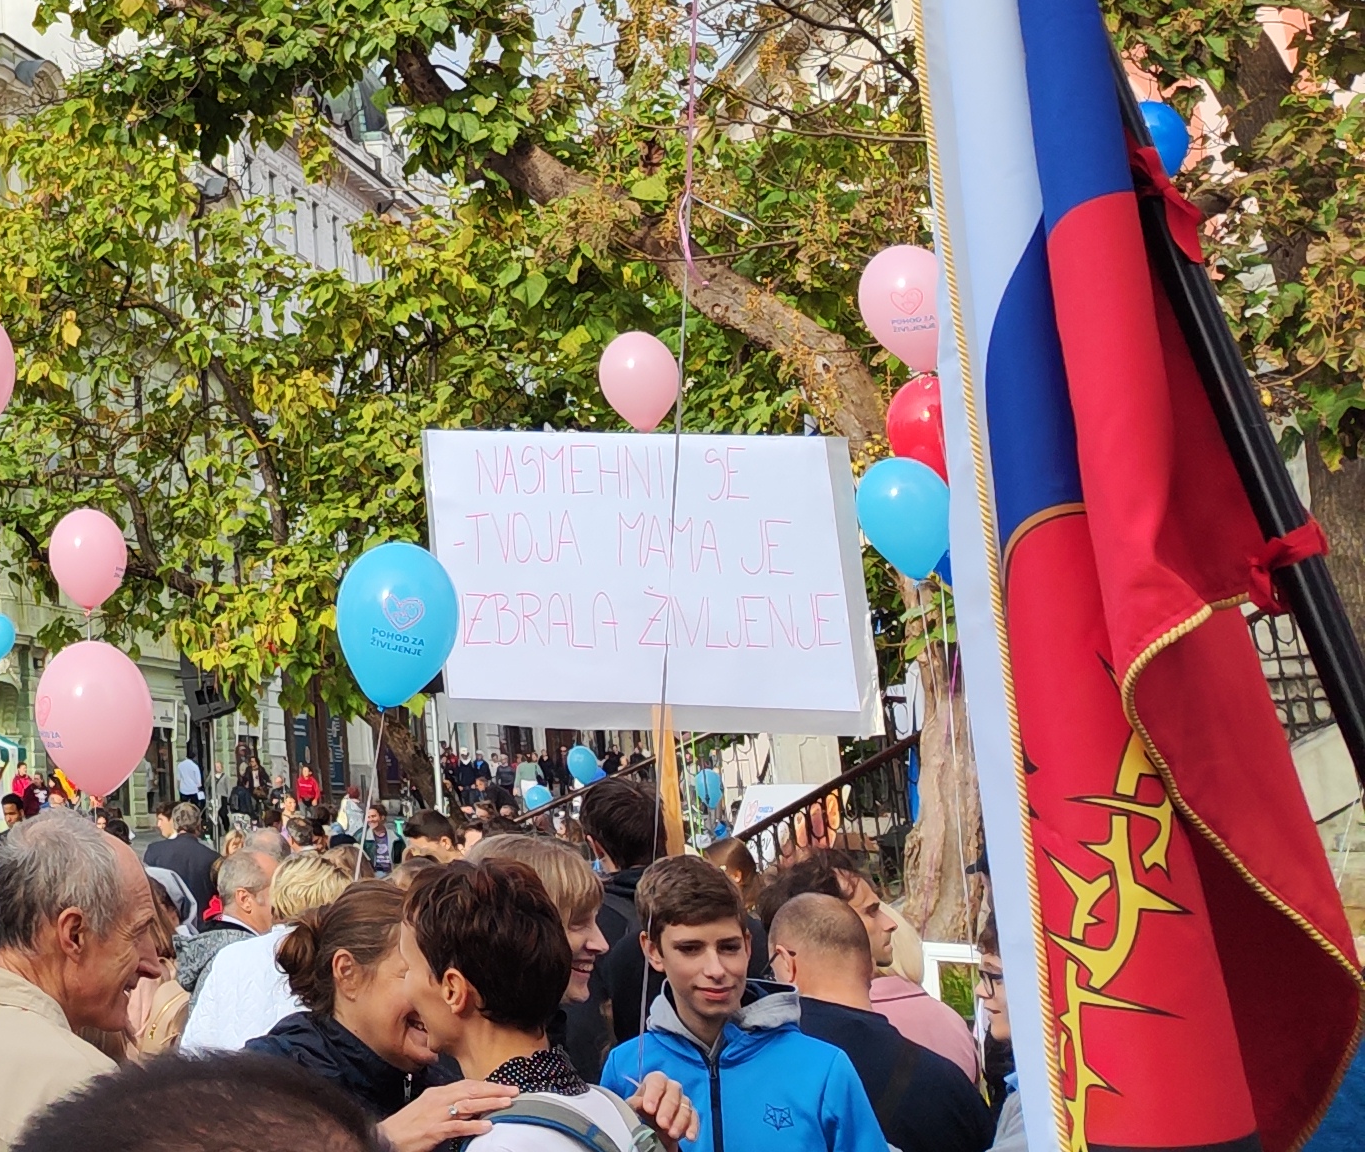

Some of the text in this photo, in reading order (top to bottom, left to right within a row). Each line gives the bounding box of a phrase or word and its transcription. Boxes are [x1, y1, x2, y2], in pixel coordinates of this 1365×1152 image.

[475, 444, 750, 501] NASMEHNI SE
[618, 511, 722, 574] MAMA
[740, 519, 795, 575] JE
[370, 636, 423, 657] ŽIVLJENJE
[371, 627, 425, 647] POHOD ZA
[461, 585, 843, 652] IZBRALA ŽIVLJENJE
